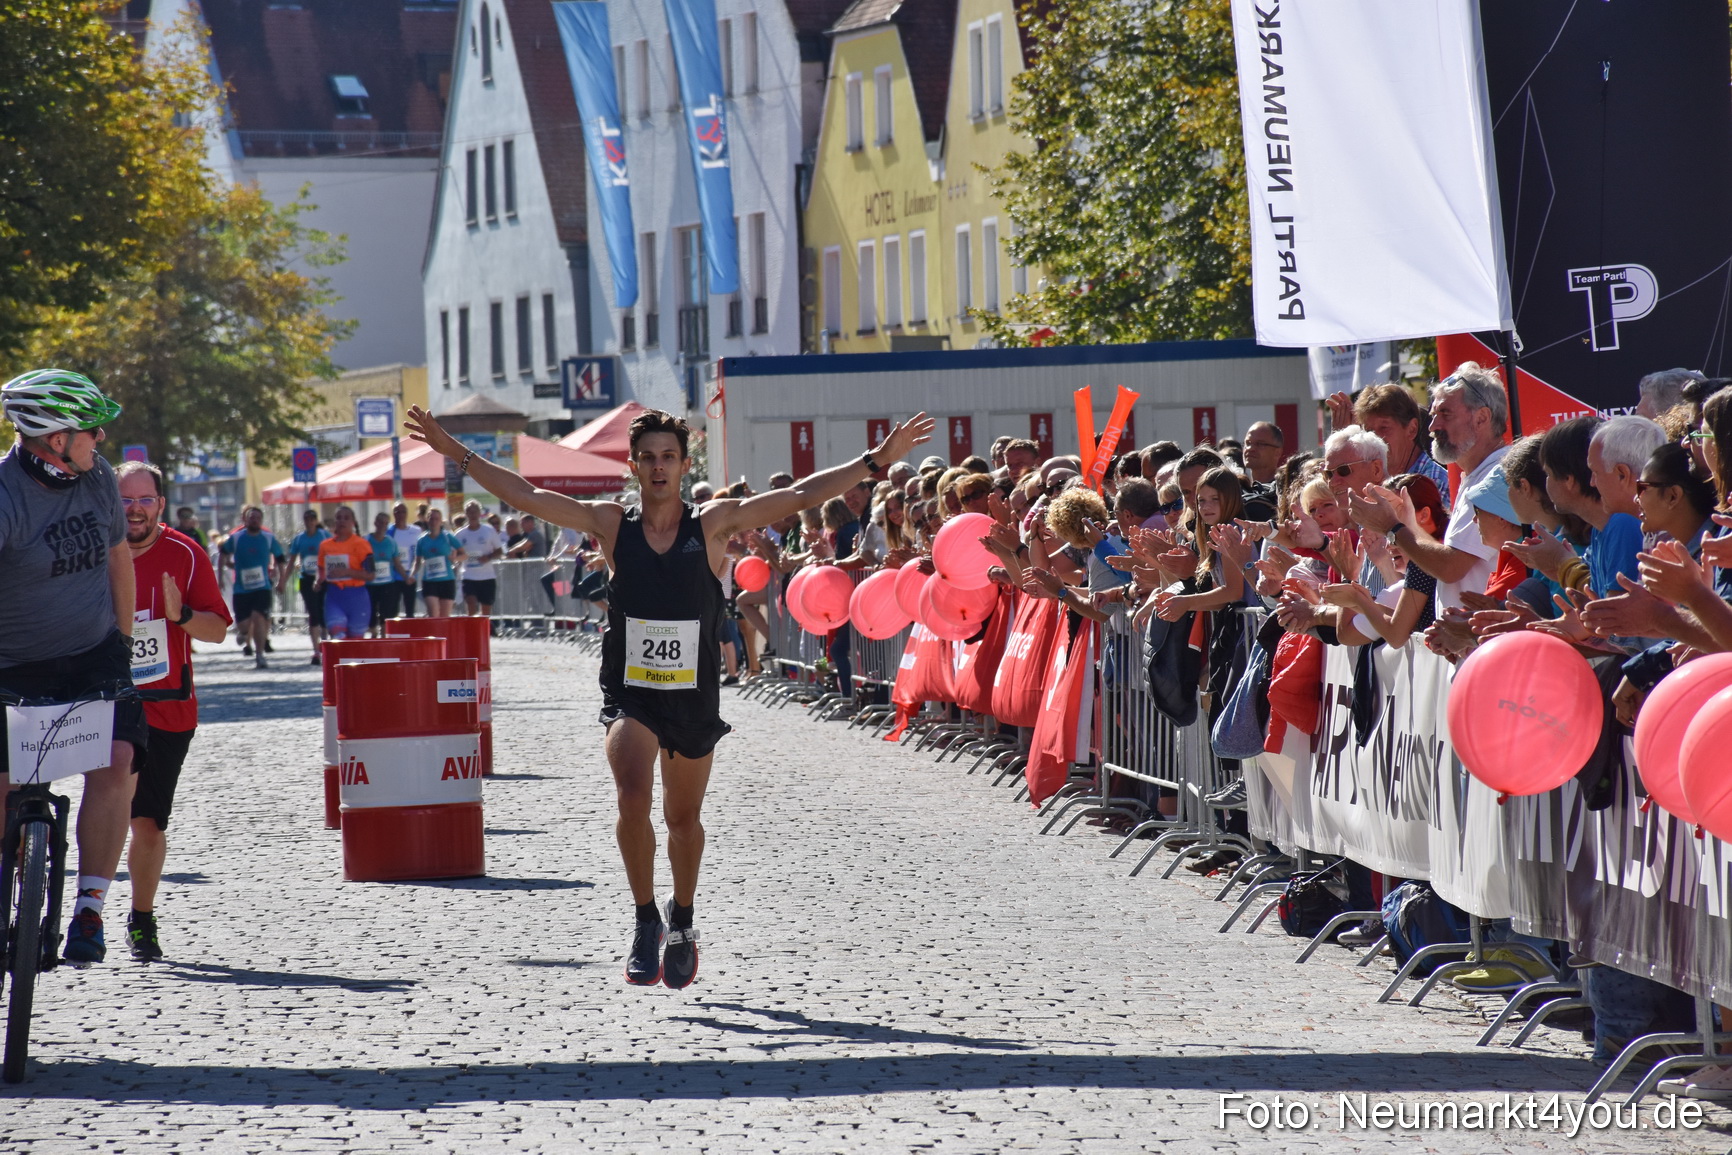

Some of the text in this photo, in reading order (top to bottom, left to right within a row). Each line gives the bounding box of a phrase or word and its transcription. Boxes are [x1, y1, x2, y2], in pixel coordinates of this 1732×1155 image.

[864, 190, 896, 227] HOTEL
[1574, 275, 1600, 283] Team
[1093, 425, 1121, 475] DEHN
[295, 473, 316, 481] TAXI
[43, 510, 99, 545] RIDE
[682, 545, 704, 553] adidas
[50, 543, 106, 578] BIKE
[642, 639, 682, 661] 248
[645, 671, 676, 682] Patrick
[40, 720, 50, 731] 1.
